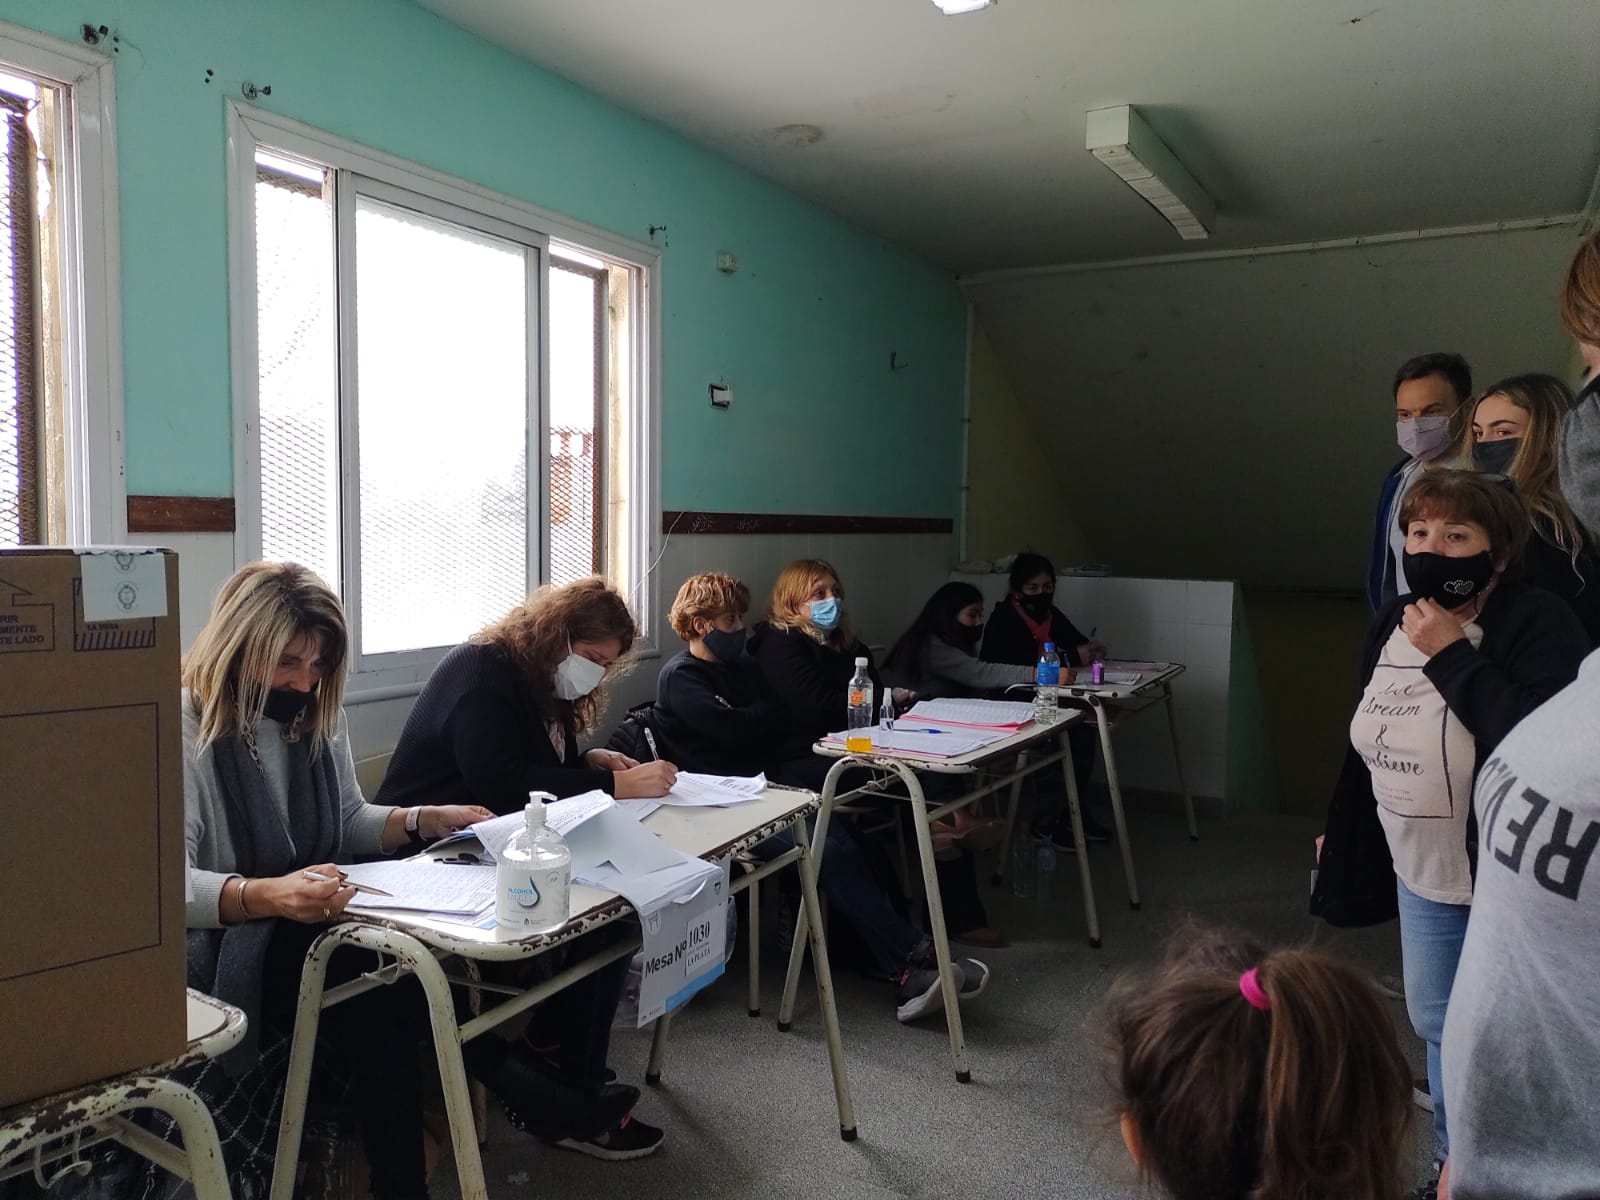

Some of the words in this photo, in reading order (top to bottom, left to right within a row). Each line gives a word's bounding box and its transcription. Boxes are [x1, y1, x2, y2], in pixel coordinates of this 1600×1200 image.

[15, 635, 45, 644] LADO
[1361, 697, 1422, 717] dream
[1375, 723, 1390, 749] &
[688, 920, 711, 948] 1030
[645, 951, 674, 979] Mesa
